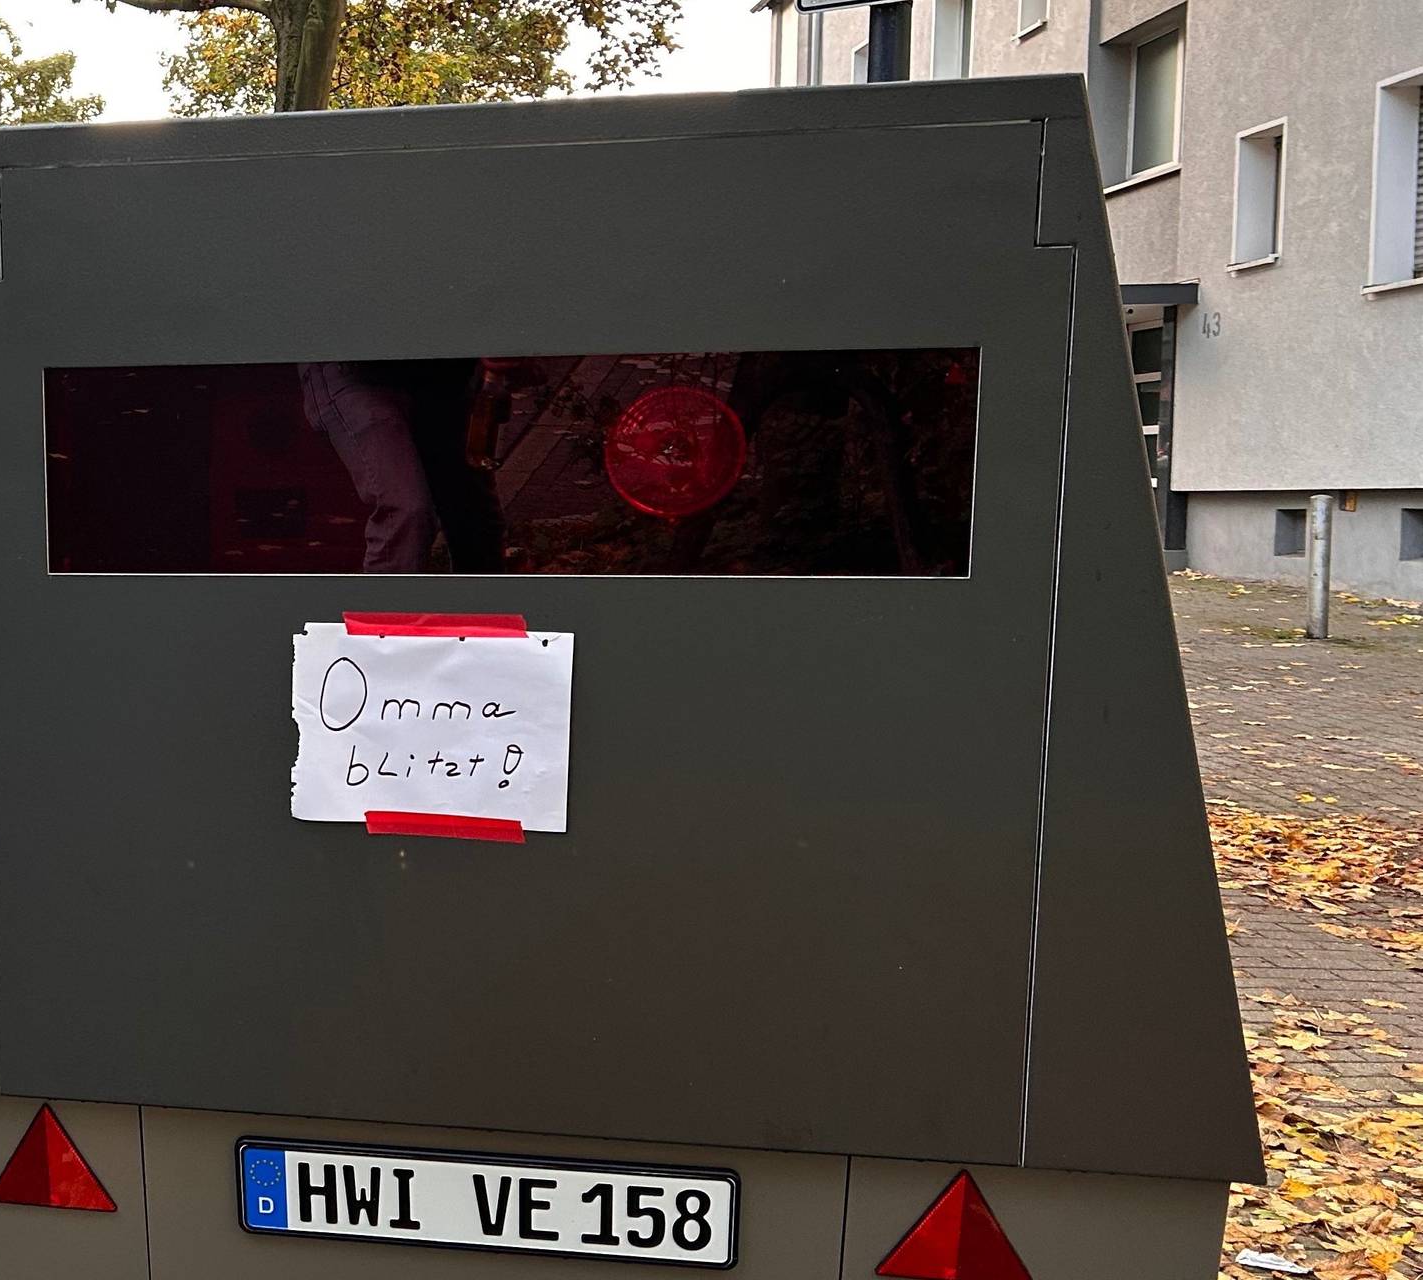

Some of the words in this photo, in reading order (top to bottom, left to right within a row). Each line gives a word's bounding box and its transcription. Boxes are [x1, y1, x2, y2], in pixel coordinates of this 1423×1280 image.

[1201, 312, 1221, 338] 43
[320, 657, 517, 731] Omma
[258, 1196, 275, 1216] D
[296, 1161, 422, 1231] HWI
[472, 1173, 562, 1241] VE
[580, 1182, 714, 1252] 158
